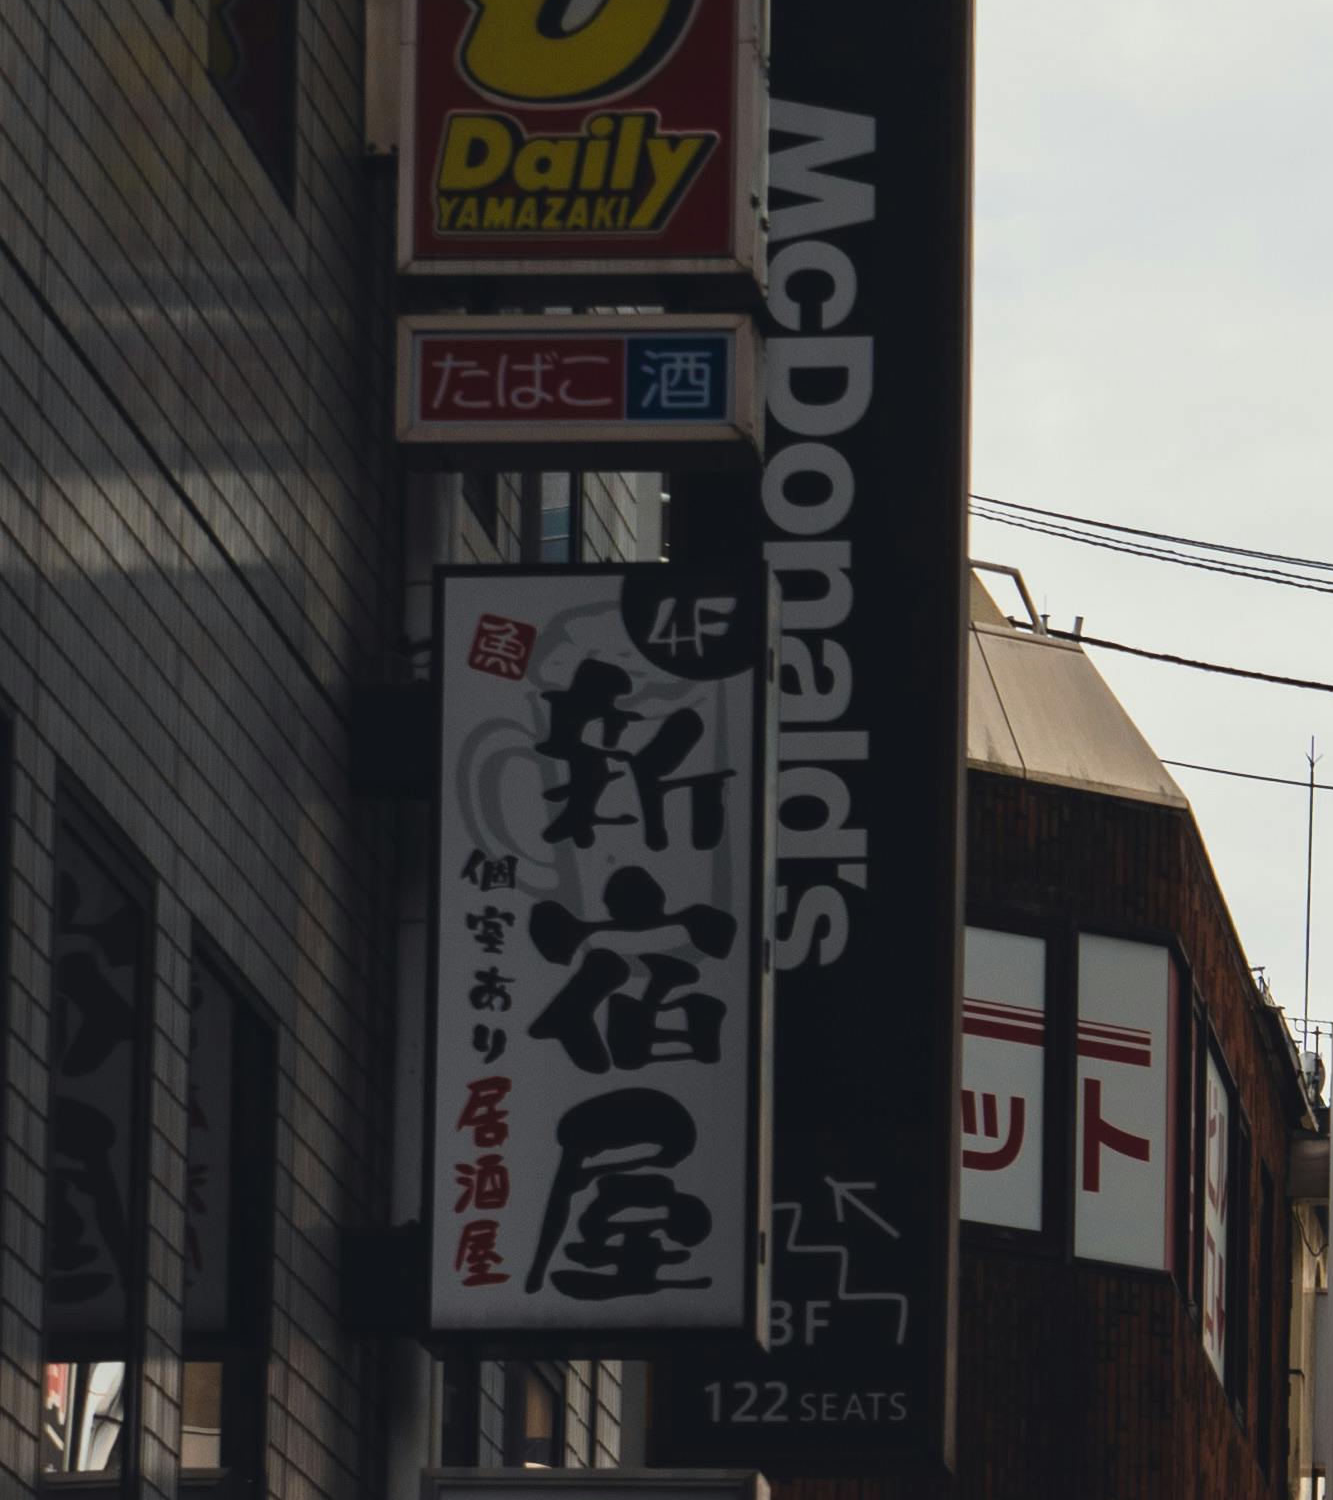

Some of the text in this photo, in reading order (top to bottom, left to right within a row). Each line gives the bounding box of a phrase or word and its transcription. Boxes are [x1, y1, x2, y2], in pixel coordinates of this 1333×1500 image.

[437, 113, 705, 229] Daily
[438, 197, 630, 230] YAMAZAKI
[432, 350, 613, 410] たばこ
[640, 350, 714, 408] 酒
[762, 98, 877, 972] McDonald's
[648, 597, 738, 658] 4F
[525, 657, 738, 1302] 新宿屋
[454, 850, 518, 1288] 個室あり 居酒屋
[705, 1380, 908, 1424] 122 SEATS
